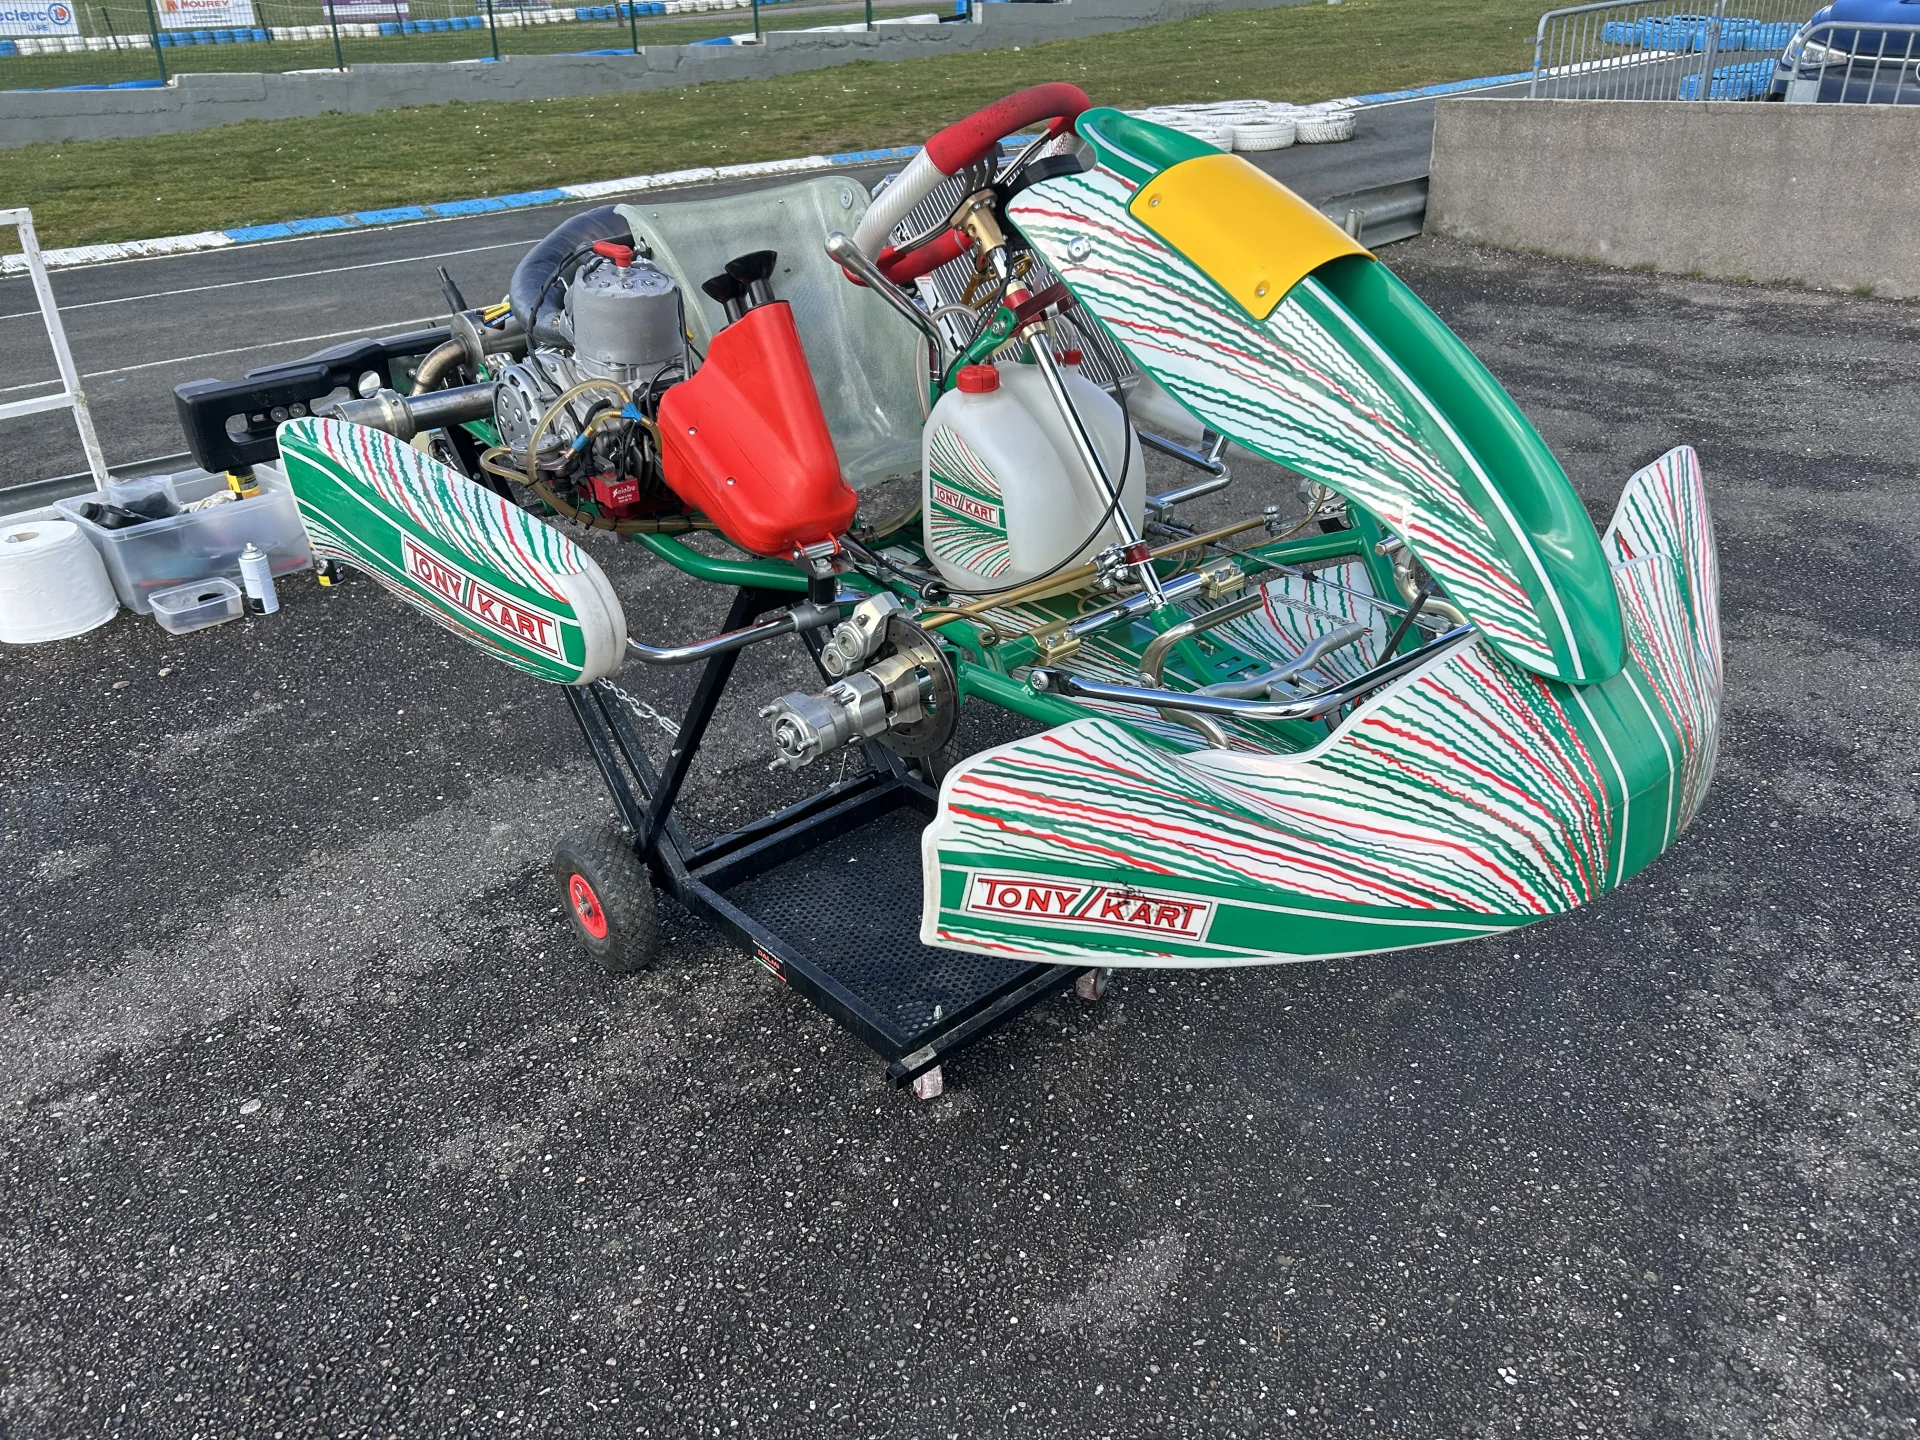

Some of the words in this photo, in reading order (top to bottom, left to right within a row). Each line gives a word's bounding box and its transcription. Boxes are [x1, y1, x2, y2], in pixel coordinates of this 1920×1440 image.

[181, 0, 229, 9] MOUREY
[934, 484, 959, 507] TONY
[965, 498, 996, 520] KART
[406, 541, 461, 600] TONY
[476, 586, 553, 645] KART
[976, 877, 1082, 915] TONY
[1099, 891, 1207, 931] KART
